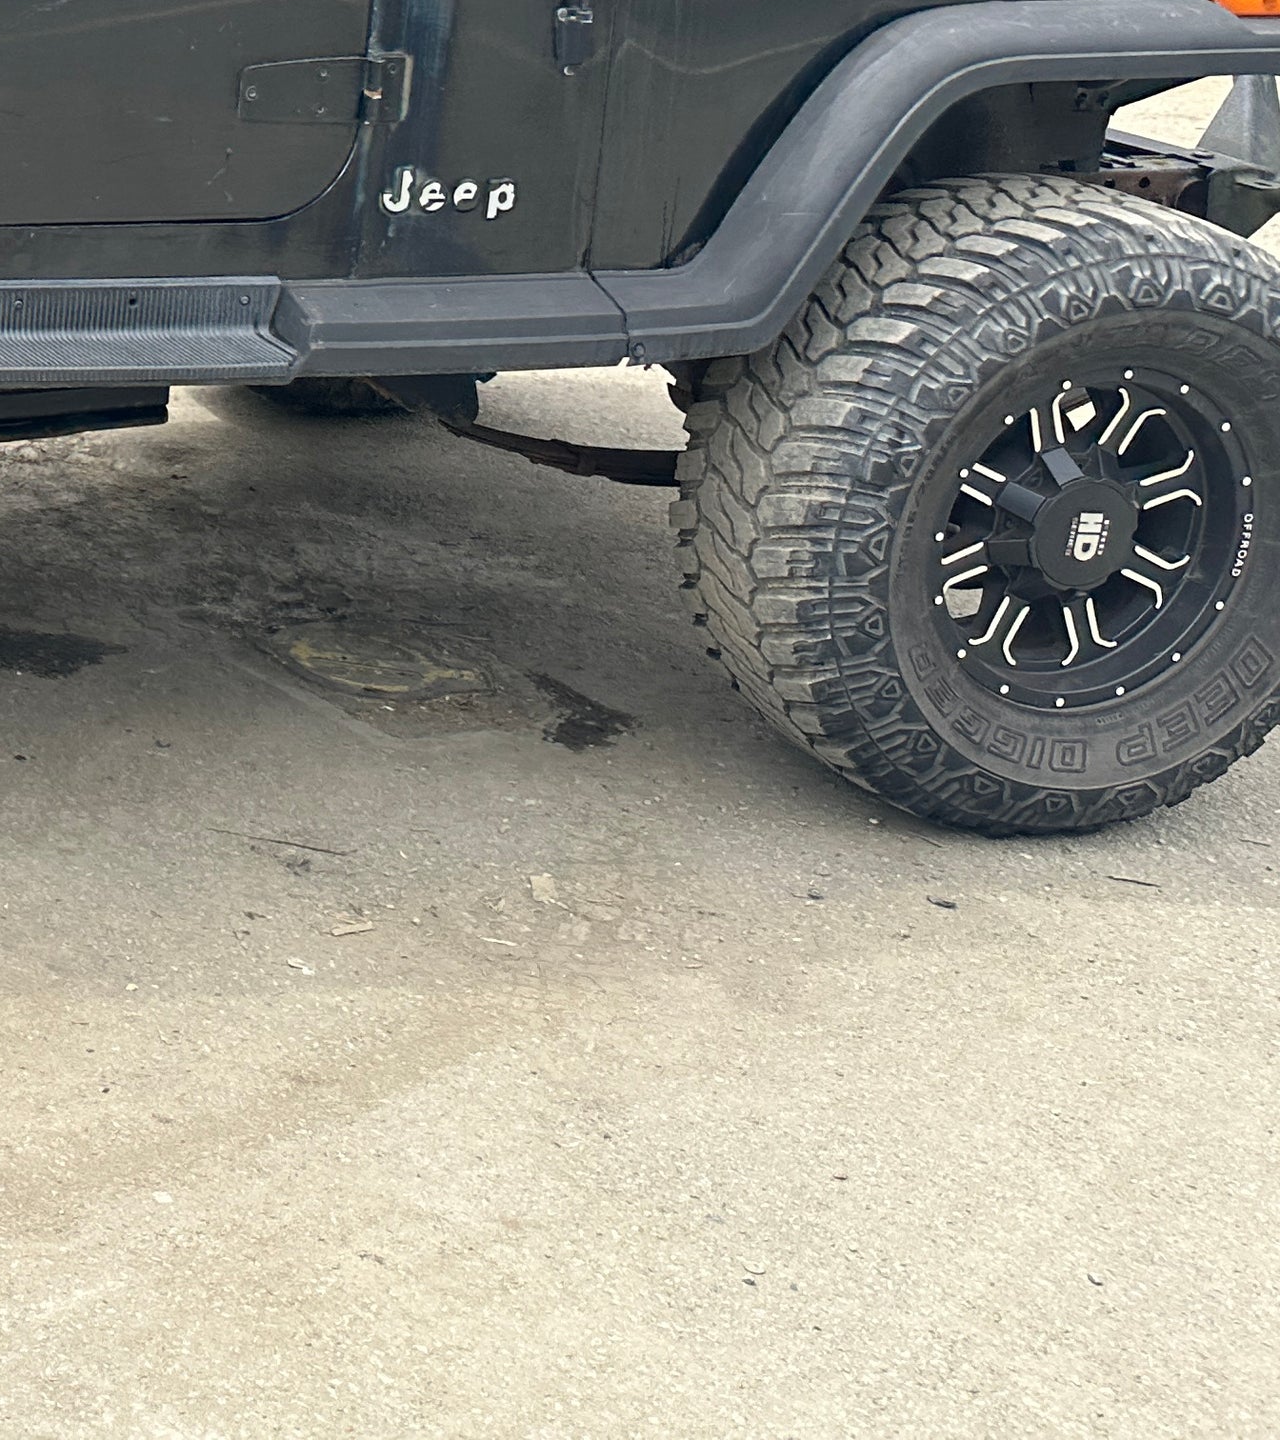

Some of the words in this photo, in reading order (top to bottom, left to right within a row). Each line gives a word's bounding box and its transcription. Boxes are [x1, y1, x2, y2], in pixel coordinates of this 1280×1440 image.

[382, 167, 516, 220] Jeep
[1073, 512, 1104, 562] HD
[1231, 512, 1255, 578] OFFROAD
[1116, 635, 1274, 767] DEEP
